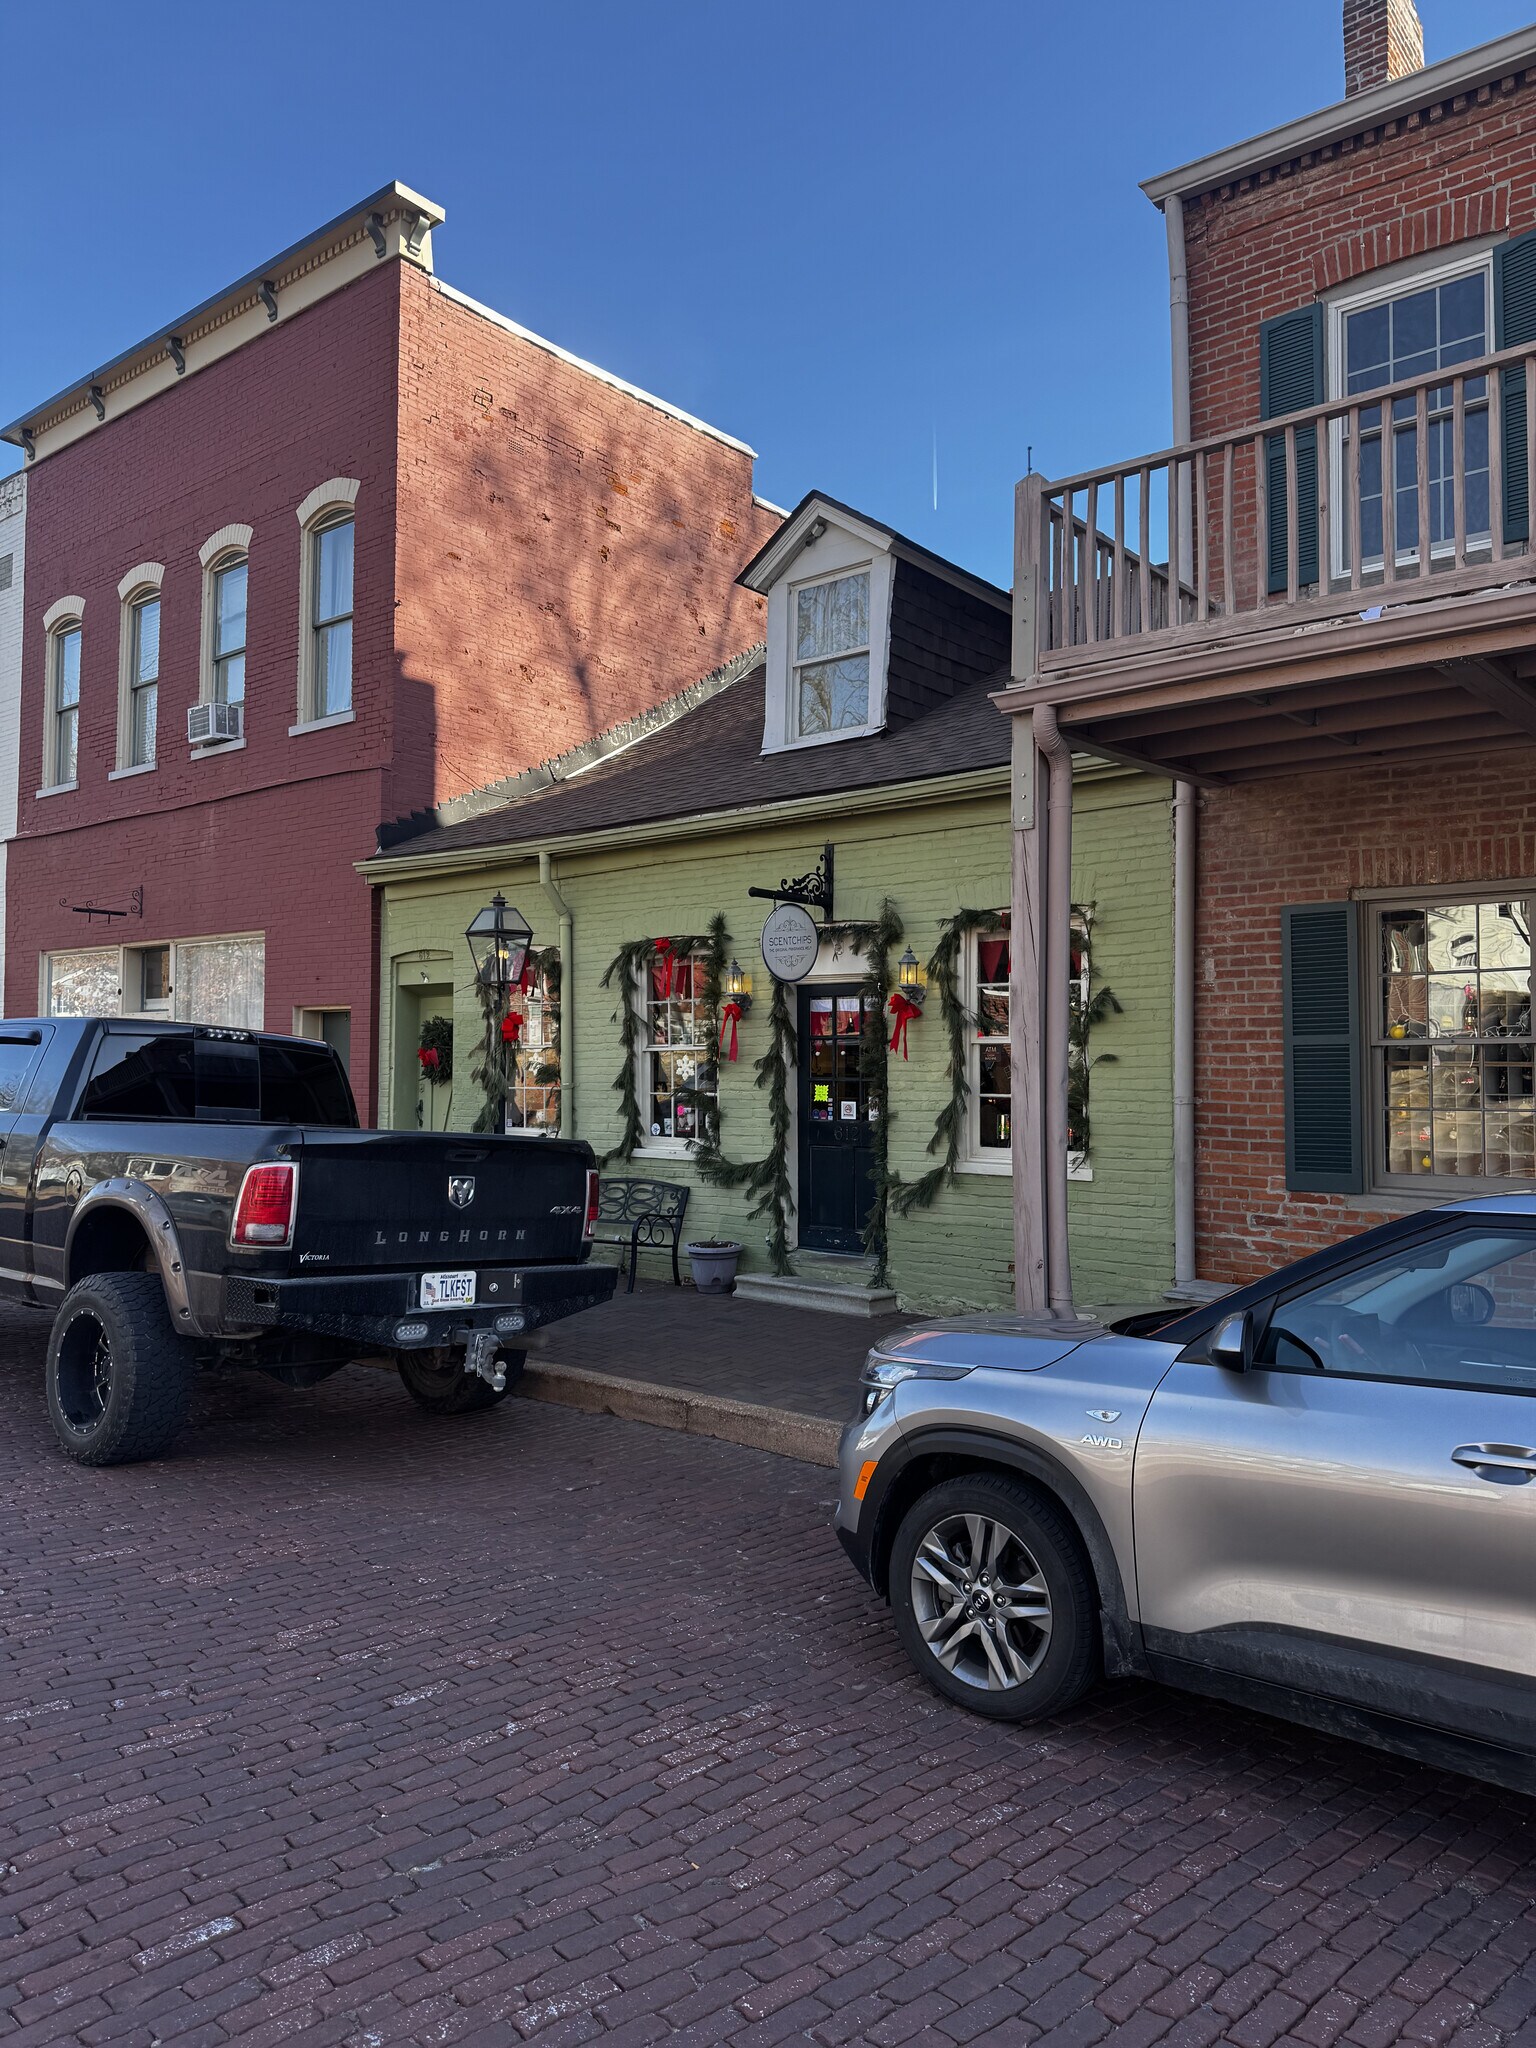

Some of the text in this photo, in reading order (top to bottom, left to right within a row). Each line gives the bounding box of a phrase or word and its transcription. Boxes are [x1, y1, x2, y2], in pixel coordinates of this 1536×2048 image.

[768, 934, 812, 947] SCENTCHIPS
[374, 1229, 527, 1245] LONGHORN
[299, 1250, 330, 1264] VICTORIA
[439, 1278, 473, 1298] TLKFST
[1080, 1433, 1124, 1450] AWD
[974, 1594, 988, 1609] KIA
